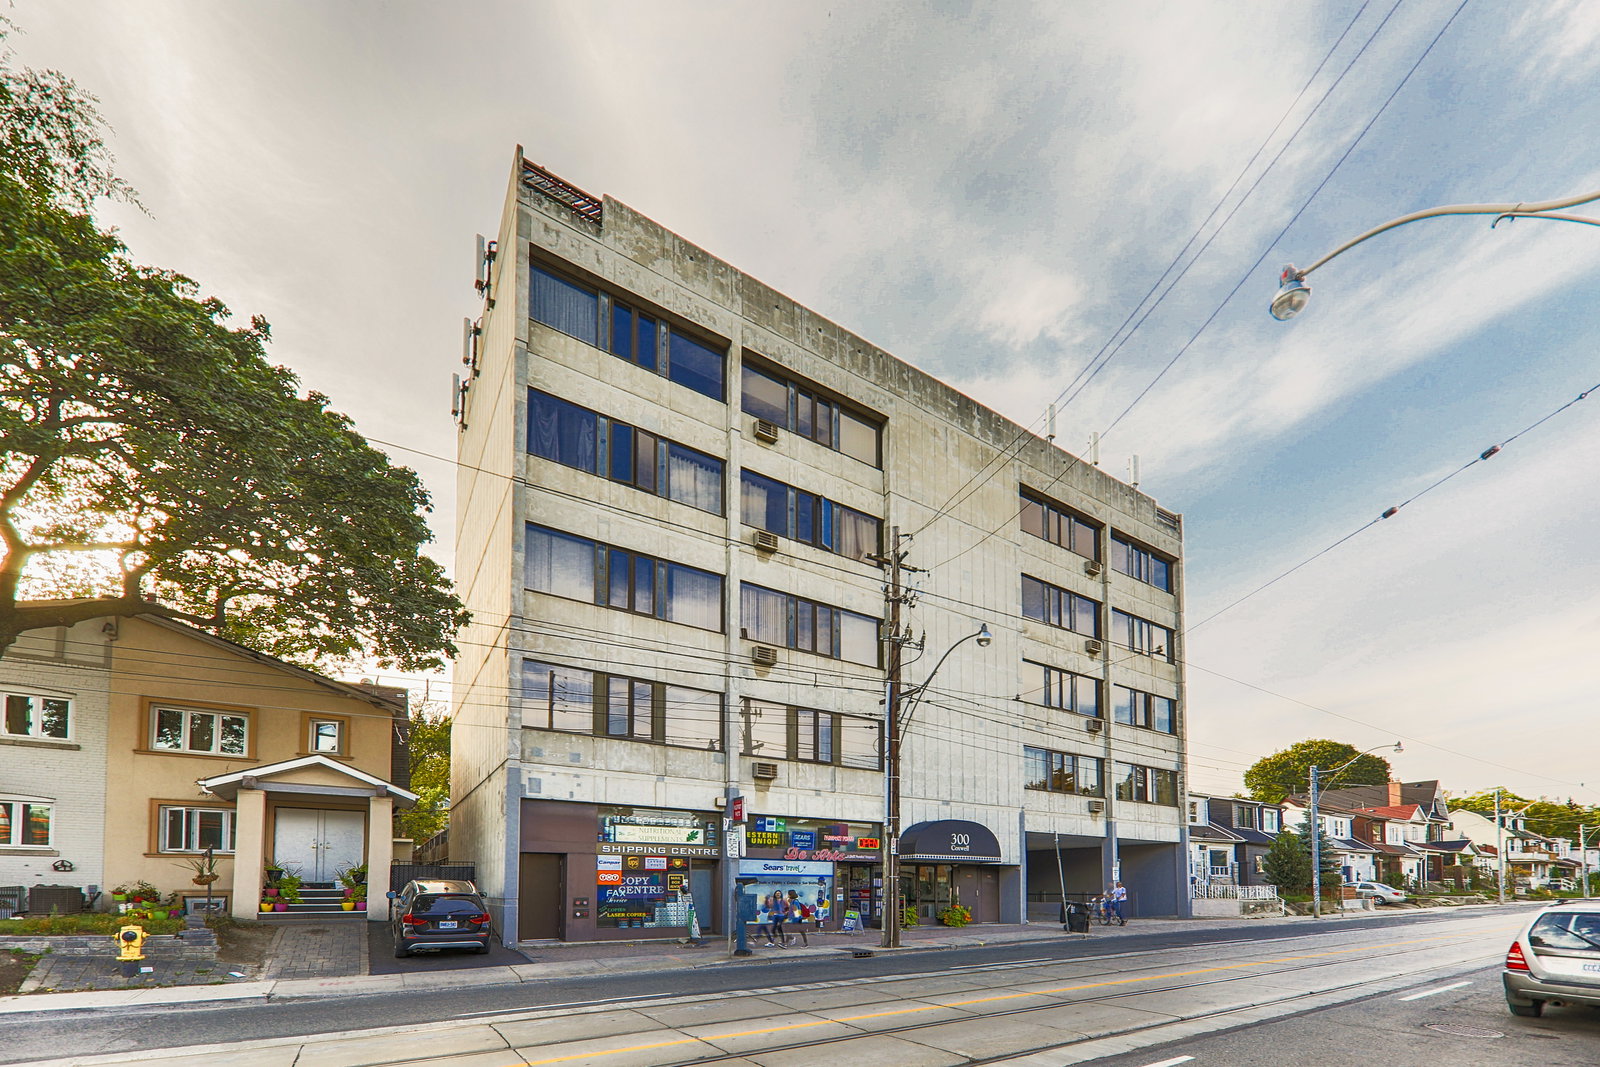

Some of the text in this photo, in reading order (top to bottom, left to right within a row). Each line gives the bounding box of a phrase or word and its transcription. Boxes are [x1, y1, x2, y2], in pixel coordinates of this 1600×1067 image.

[859, 839, 879, 848] OPEN
[950, 833, 970, 846] 300
[602, 846, 666, 854] SHIPPING
[763, 863, 784, 872] Sears
[621, 877, 650, 886] COPY
[606, 889, 626, 897] FAX
[618, 885, 664, 894] CENTRE
